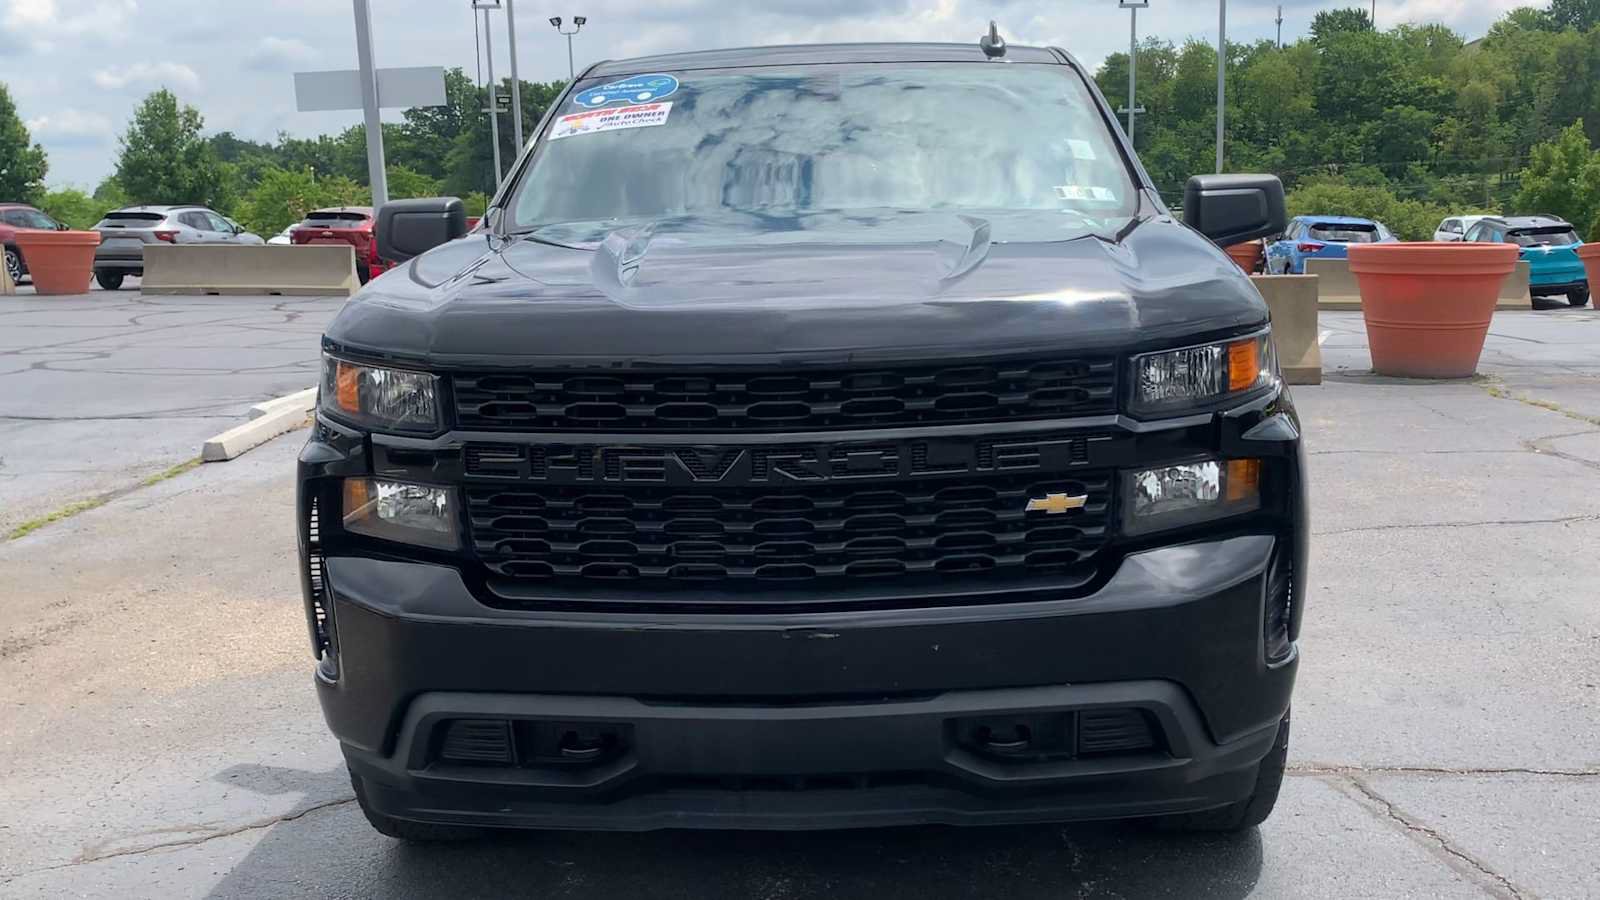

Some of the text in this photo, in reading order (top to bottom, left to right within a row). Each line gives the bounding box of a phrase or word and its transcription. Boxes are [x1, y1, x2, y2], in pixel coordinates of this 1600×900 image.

[600, 111, 665, 123] ONE OWNER
[463, 435, 1112, 482] CHEVROLET
